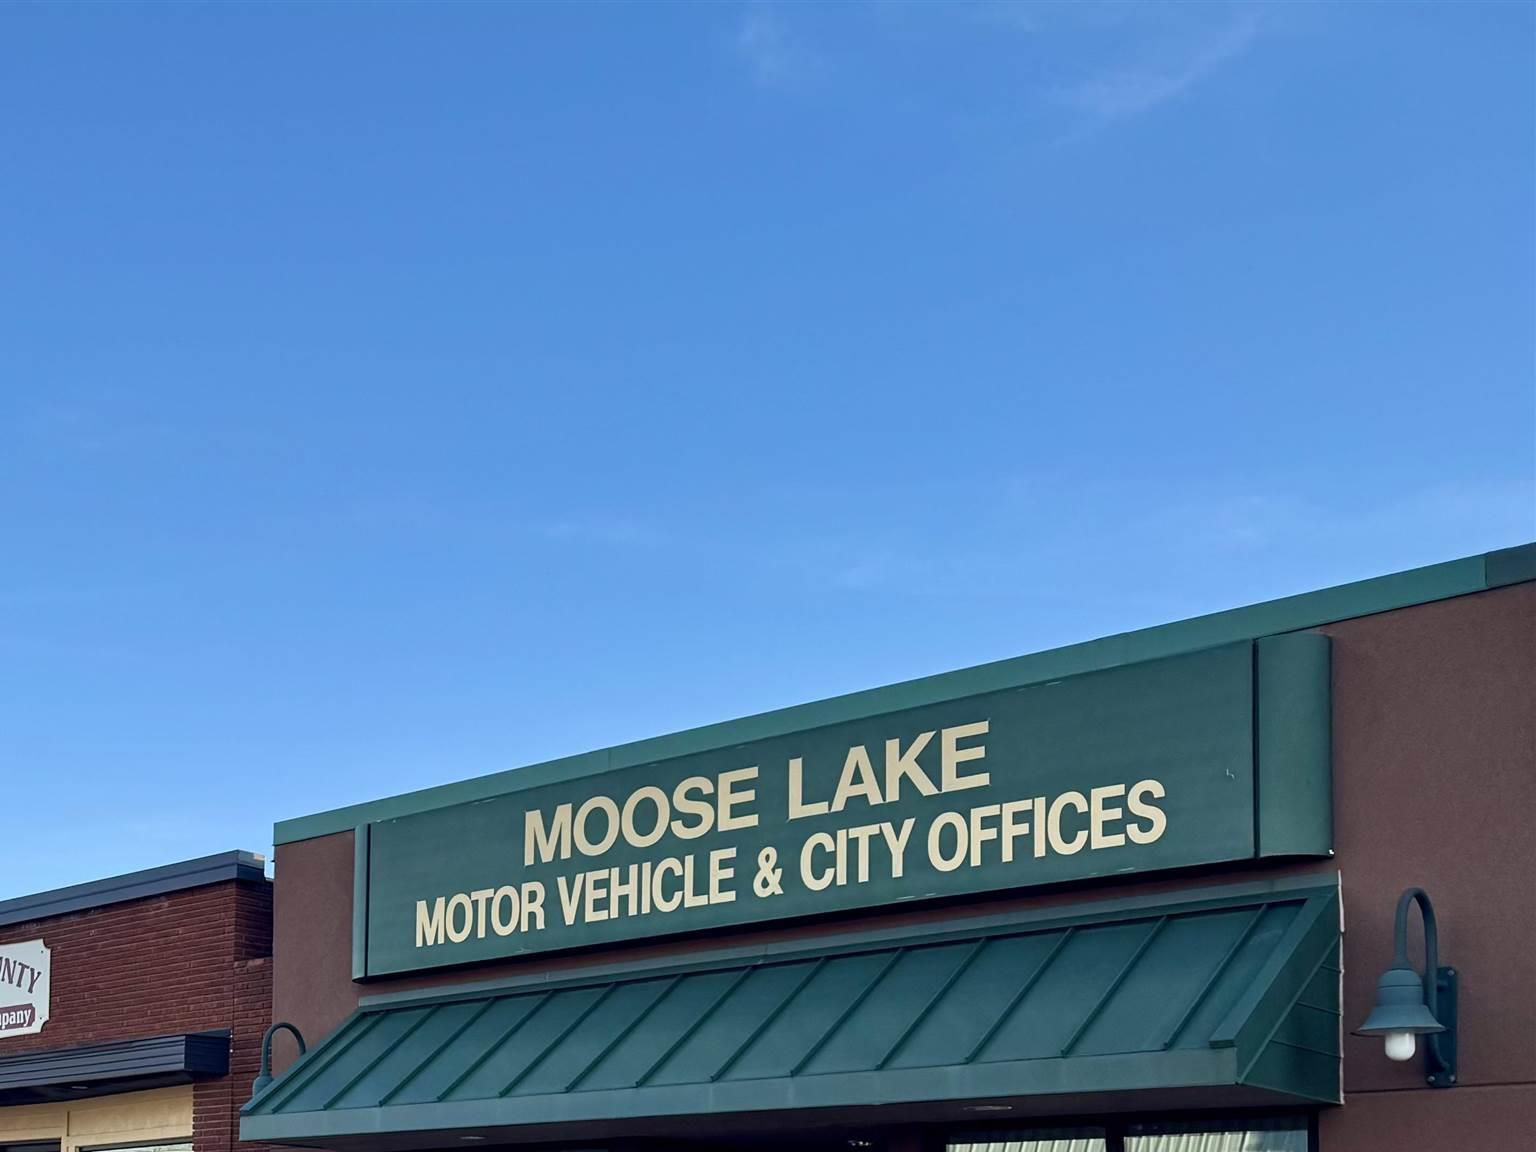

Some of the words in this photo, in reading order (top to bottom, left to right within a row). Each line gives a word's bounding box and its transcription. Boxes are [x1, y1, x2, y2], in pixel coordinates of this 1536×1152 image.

[415, 881, 546, 948] MOTOR
[557, 847, 737, 925] VEHICLE
[753, 846, 784, 897] &
[799, 818, 915, 892] CITY
[927, 779, 1167, 872] OFFICES
[524, 766, 760, 866] MOOSE
[788, 720, 991, 821] LAKE
